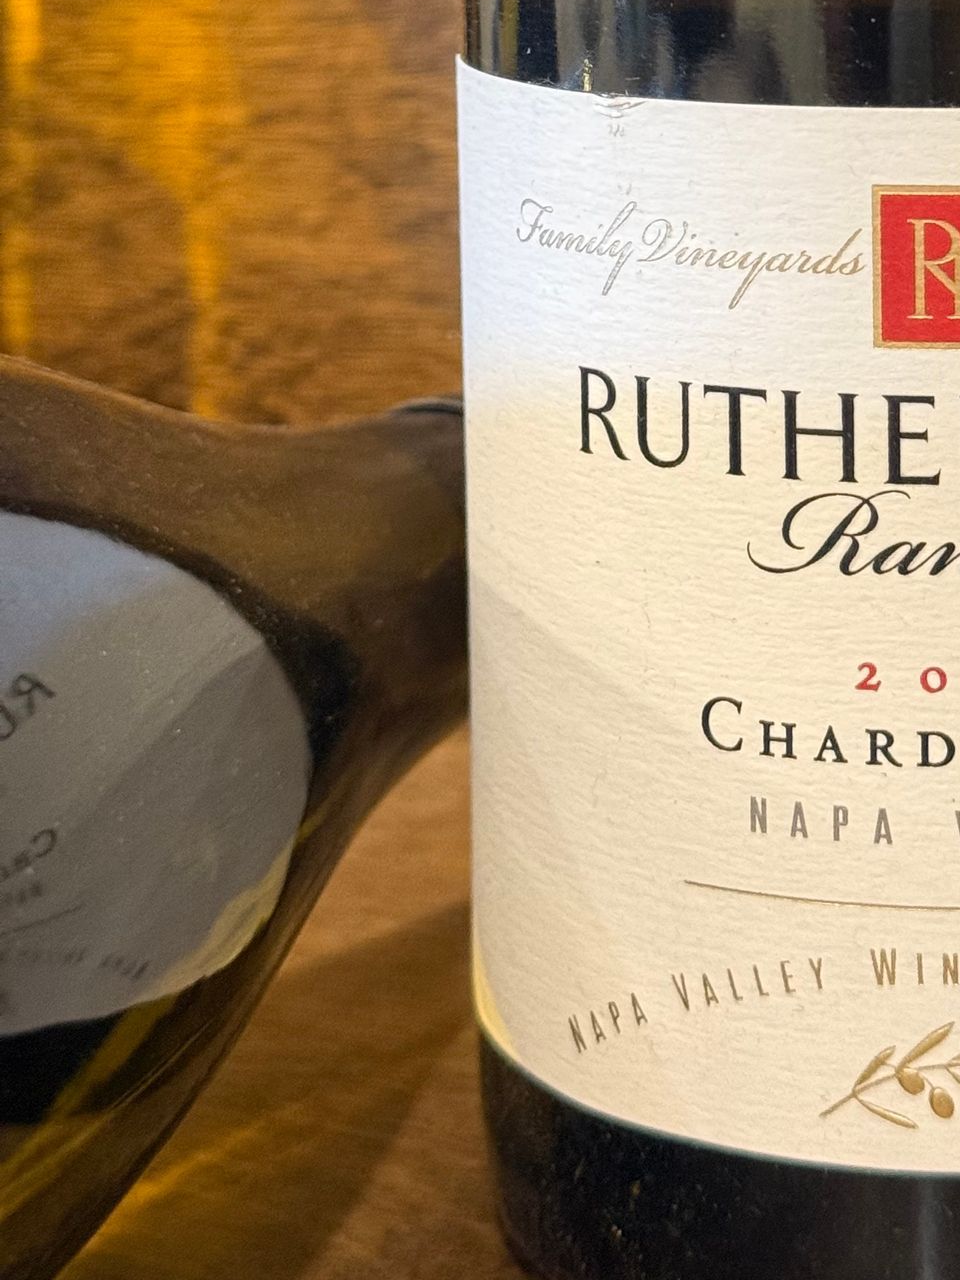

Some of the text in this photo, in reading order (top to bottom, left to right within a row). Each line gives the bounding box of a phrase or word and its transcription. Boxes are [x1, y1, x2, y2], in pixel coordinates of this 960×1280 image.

[515, 198, 866, 309] Family Vineyards
[749, 795, 894, 846] NAPA
[567, 992, 649, 1054] NAPA
[671, 957, 824, 1013] VALLEY
